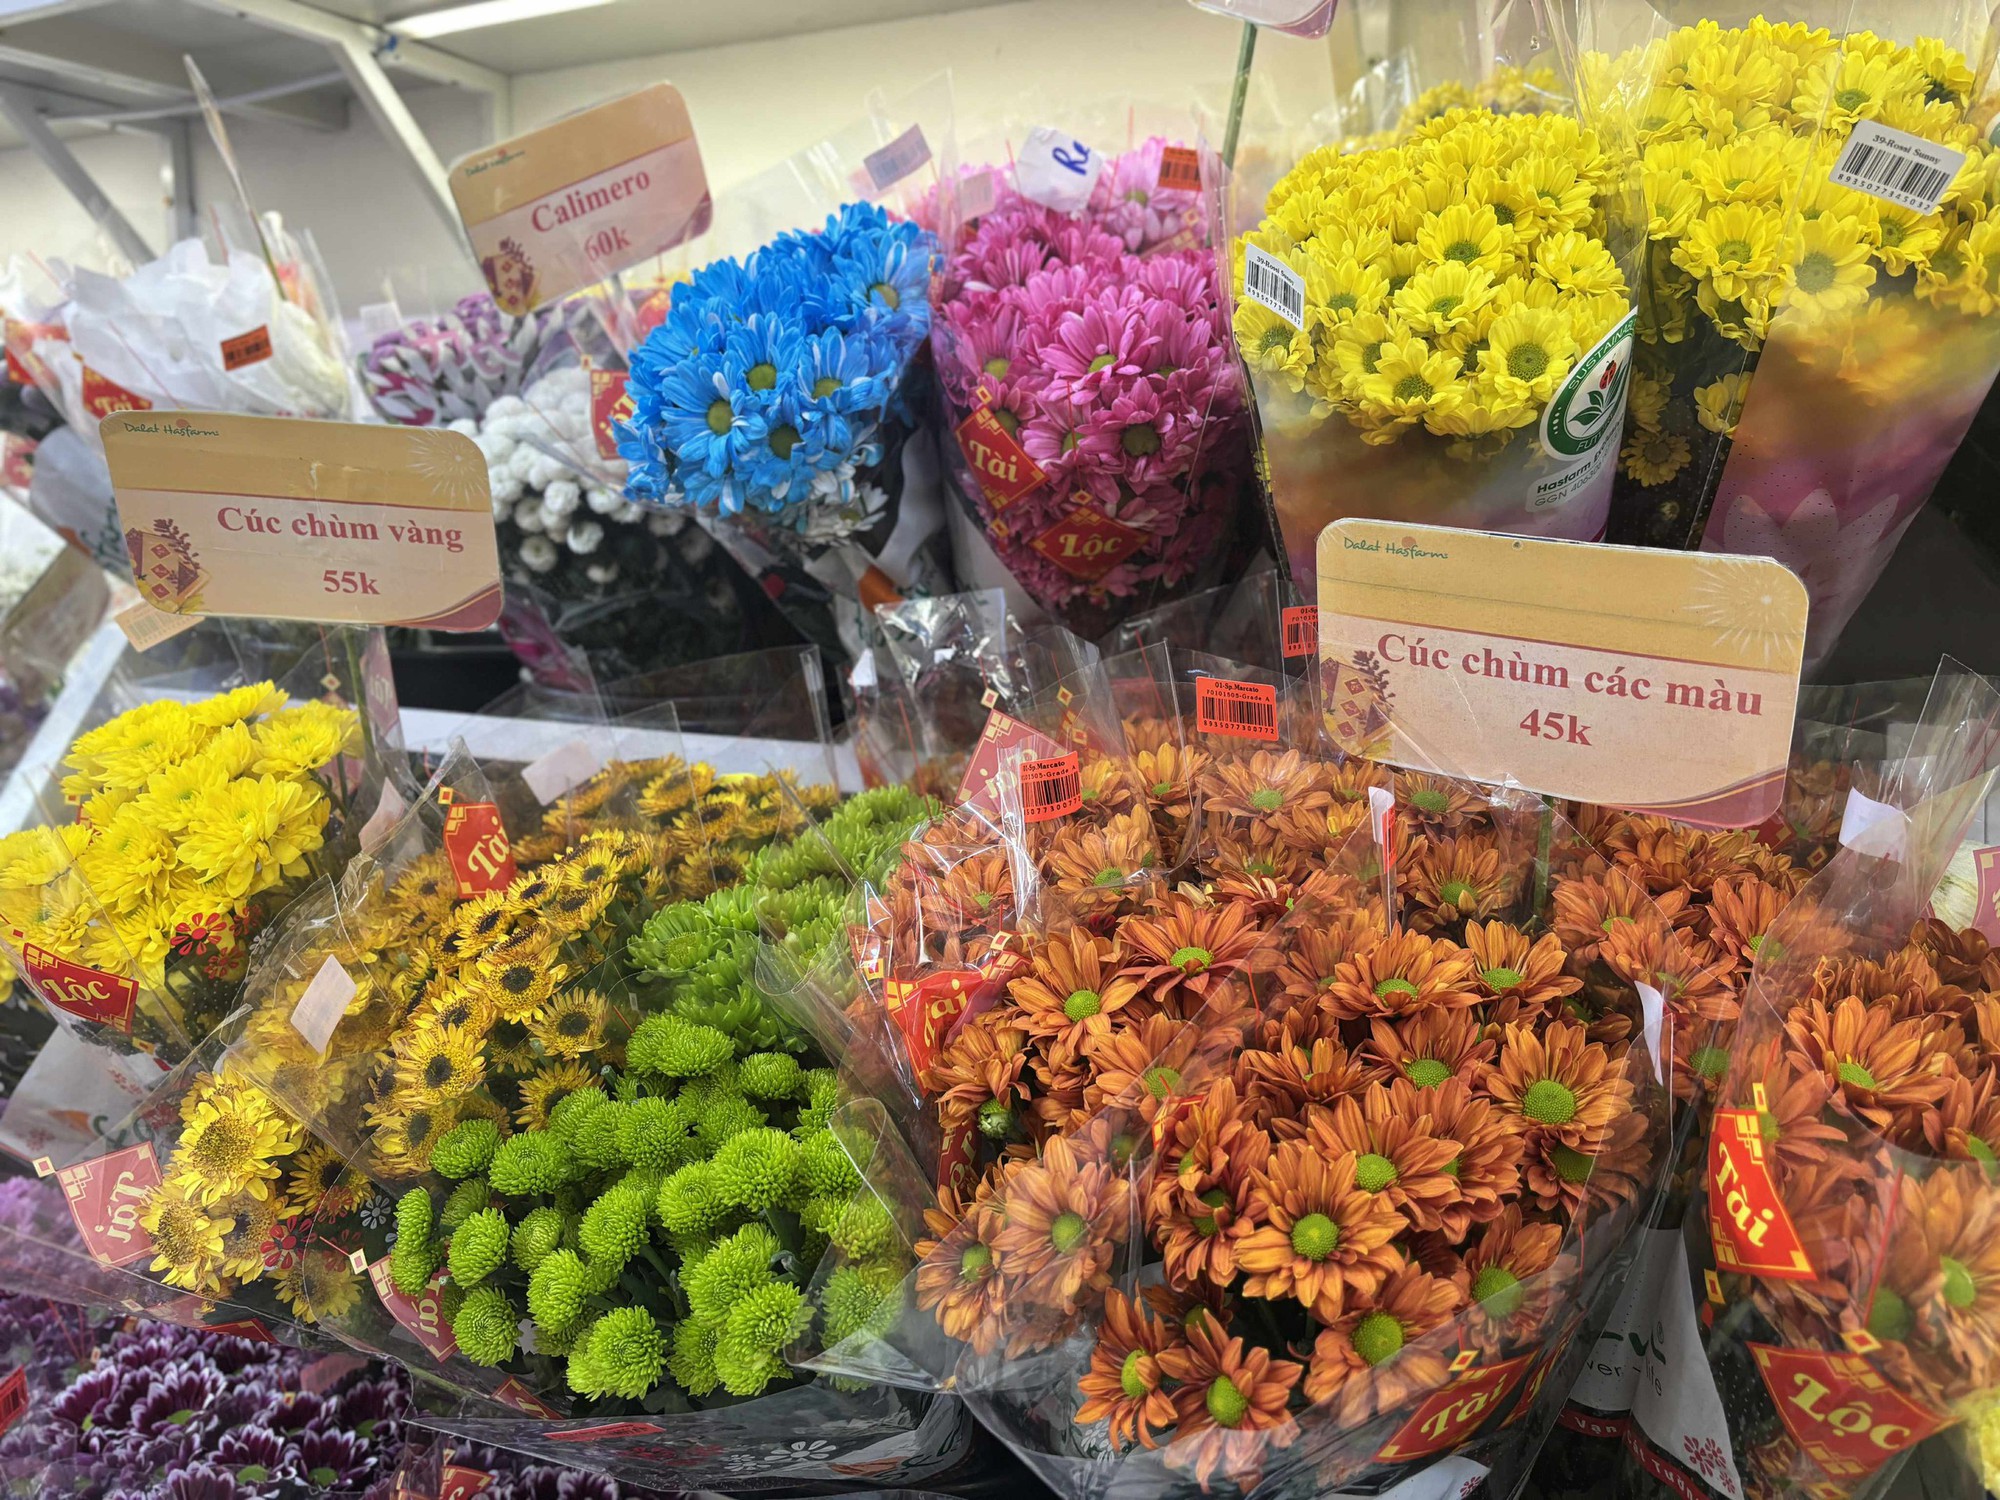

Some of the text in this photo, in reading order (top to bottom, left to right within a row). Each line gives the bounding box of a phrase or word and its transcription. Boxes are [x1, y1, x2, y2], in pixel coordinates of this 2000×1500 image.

[1872, 134, 1941, 165] 39-Rossi Sunny
[531, 171, 650, 233] Calimero
[583, 226, 632, 262] 60k
[124, 422, 160, 433] Dalat
[969, 440, 1018, 482] Tài
[1537, 462, 1591, 493] Hasfarm
[1535, 490, 1567, 506] GGN
[217, 506, 465, 553] Cúc chùm vàng
[1343, 536, 1380, 552] Dalat
[1059, 533, 1122, 560] Lộc
[323, 569, 381, 596] 55k
[1377, 633, 1763, 717] Cúc chùm các màu
[1203, 720, 1275, 734] 8935077300772
[1519, 708, 1593, 747] 45k
[41, 976, 110, 1006] Lộc
[1715, 1141, 1775, 1247] Tài
[1420, 1372, 1508, 1441] Tài
[1788, 1372, 1911, 1450] Lộc
